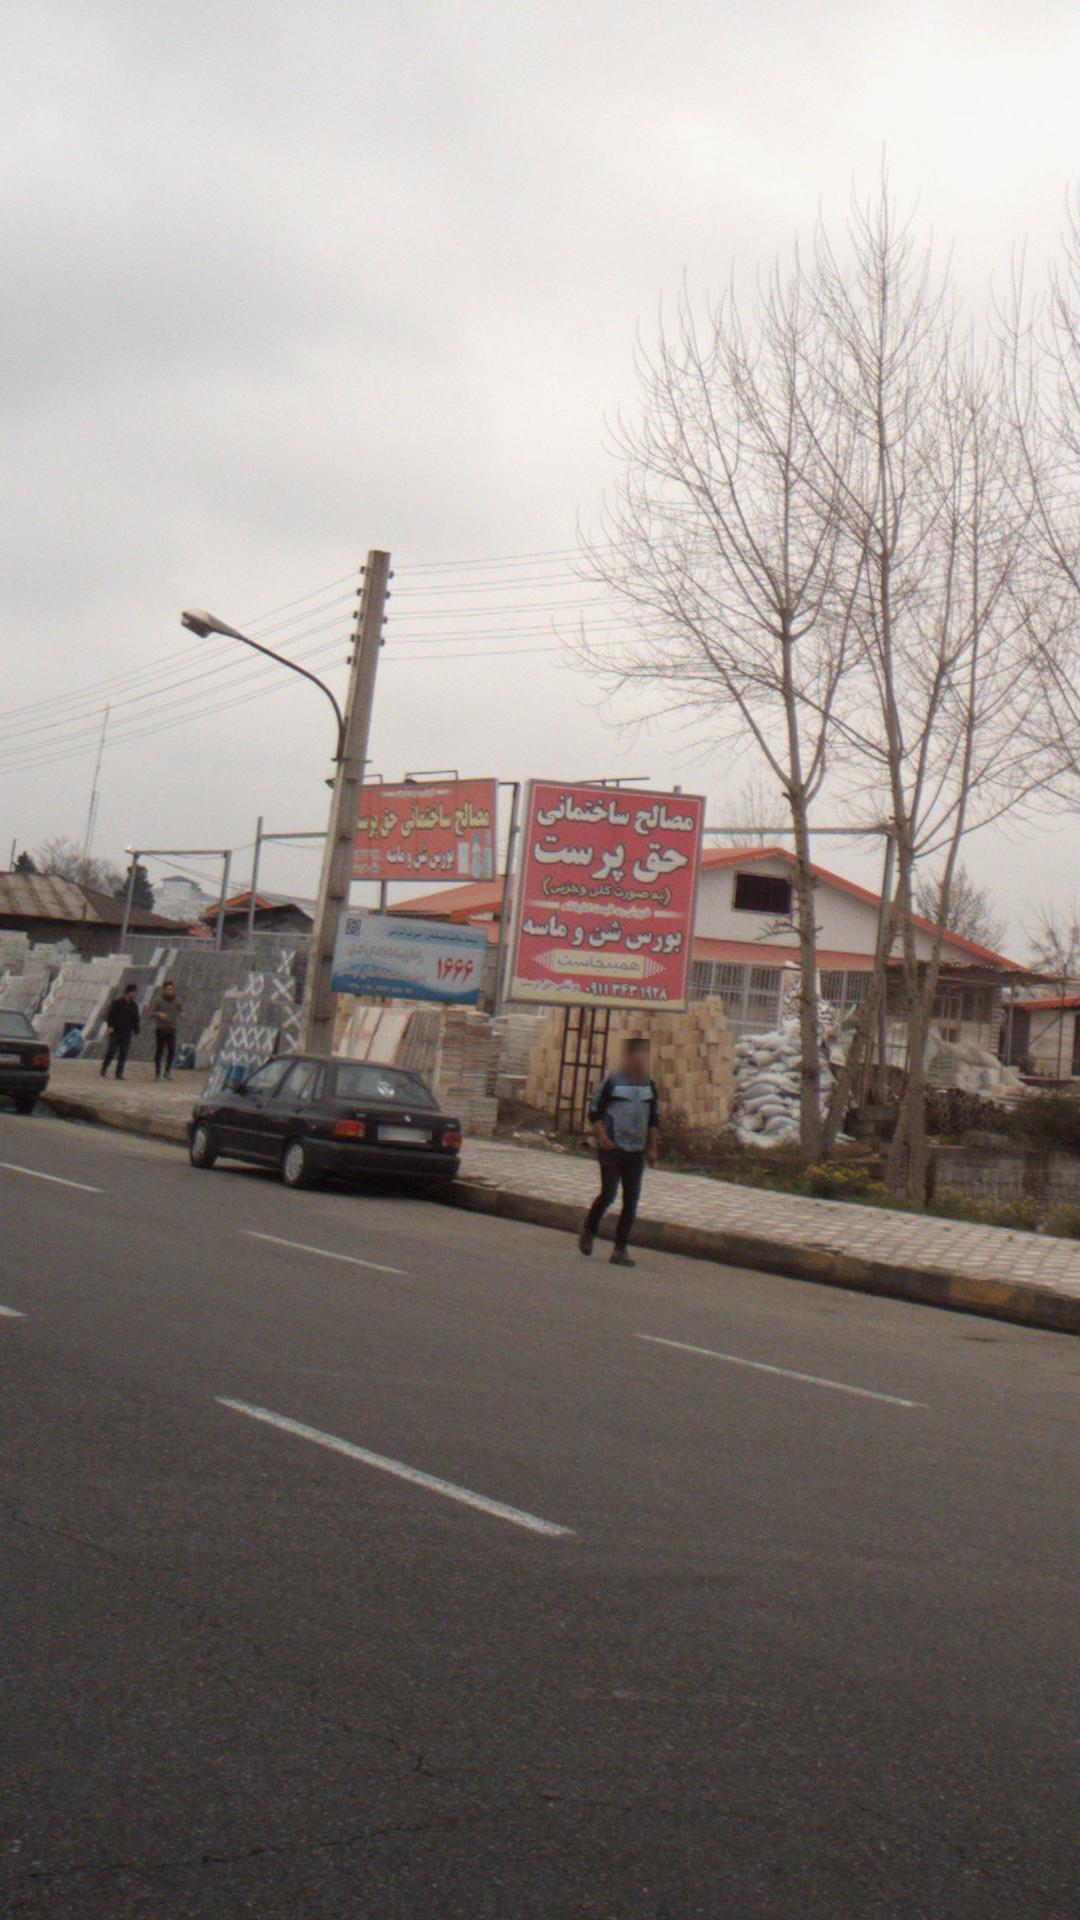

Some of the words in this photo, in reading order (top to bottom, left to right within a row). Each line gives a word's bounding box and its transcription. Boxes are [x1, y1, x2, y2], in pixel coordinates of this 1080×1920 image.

[380, 807, 398, 838] حق
[400, 799, 451, 838] ساختمانی
[453, 799, 490, 836] مصالح
[536, 793, 631, 826] ساختمانی
[634, 803, 695, 835] مصالح
[428, 847, 455, 871] بورس
[533, 833, 626, 882] پرست
[632, 841, 689, 883] حق
[614, 886, 650, 901] صورت
[522, 914, 569, 938] ماسه
[571, 928, 584, 947] و
[588, 920, 622, 947] شن
[625, 930, 683, 954] بورس
[437, 956, 476, 982] ۱۶۶۶
